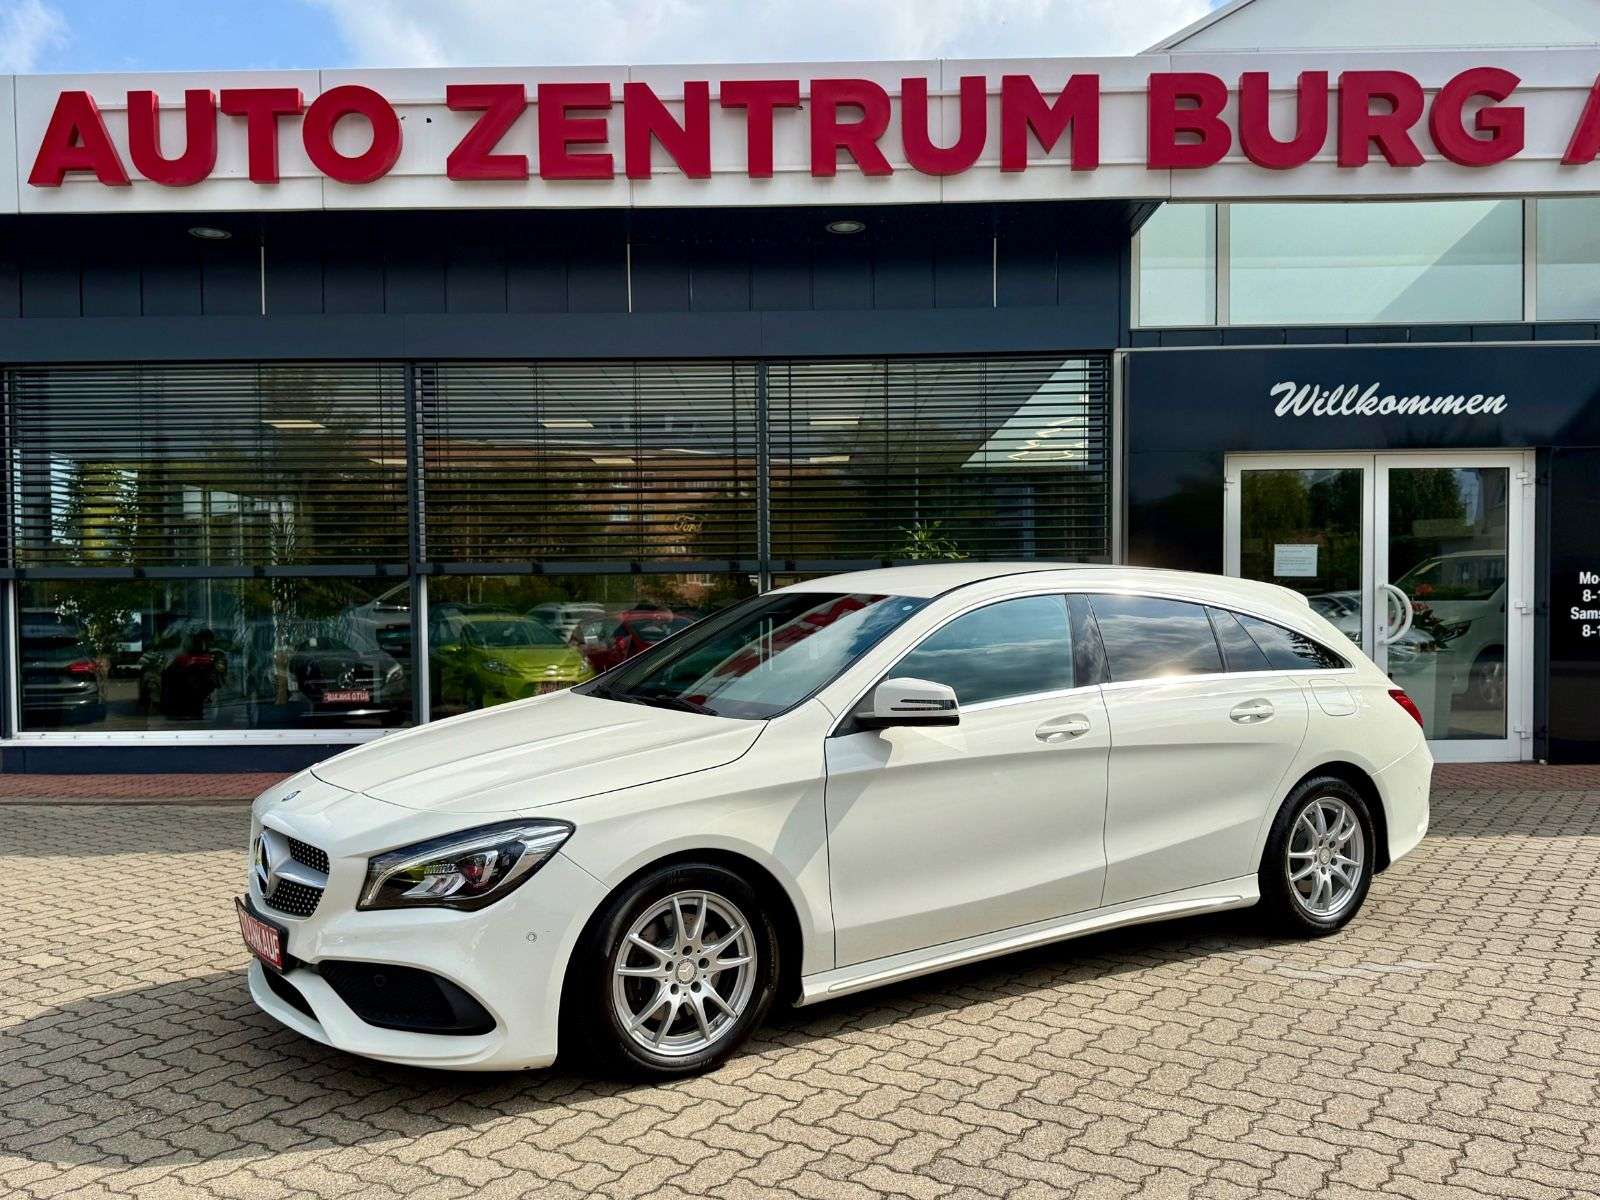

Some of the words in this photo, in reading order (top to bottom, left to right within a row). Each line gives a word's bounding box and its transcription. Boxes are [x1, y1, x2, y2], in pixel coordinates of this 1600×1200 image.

[27, 85, 403, 187] AUTO
[446, 74, 1099, 181] ZENTRUM
[1147, 67, 1524, 170] BURG
[1270, 381, 1508, 417] Willkommen
[1570, 606, 1600, 620] Sam
